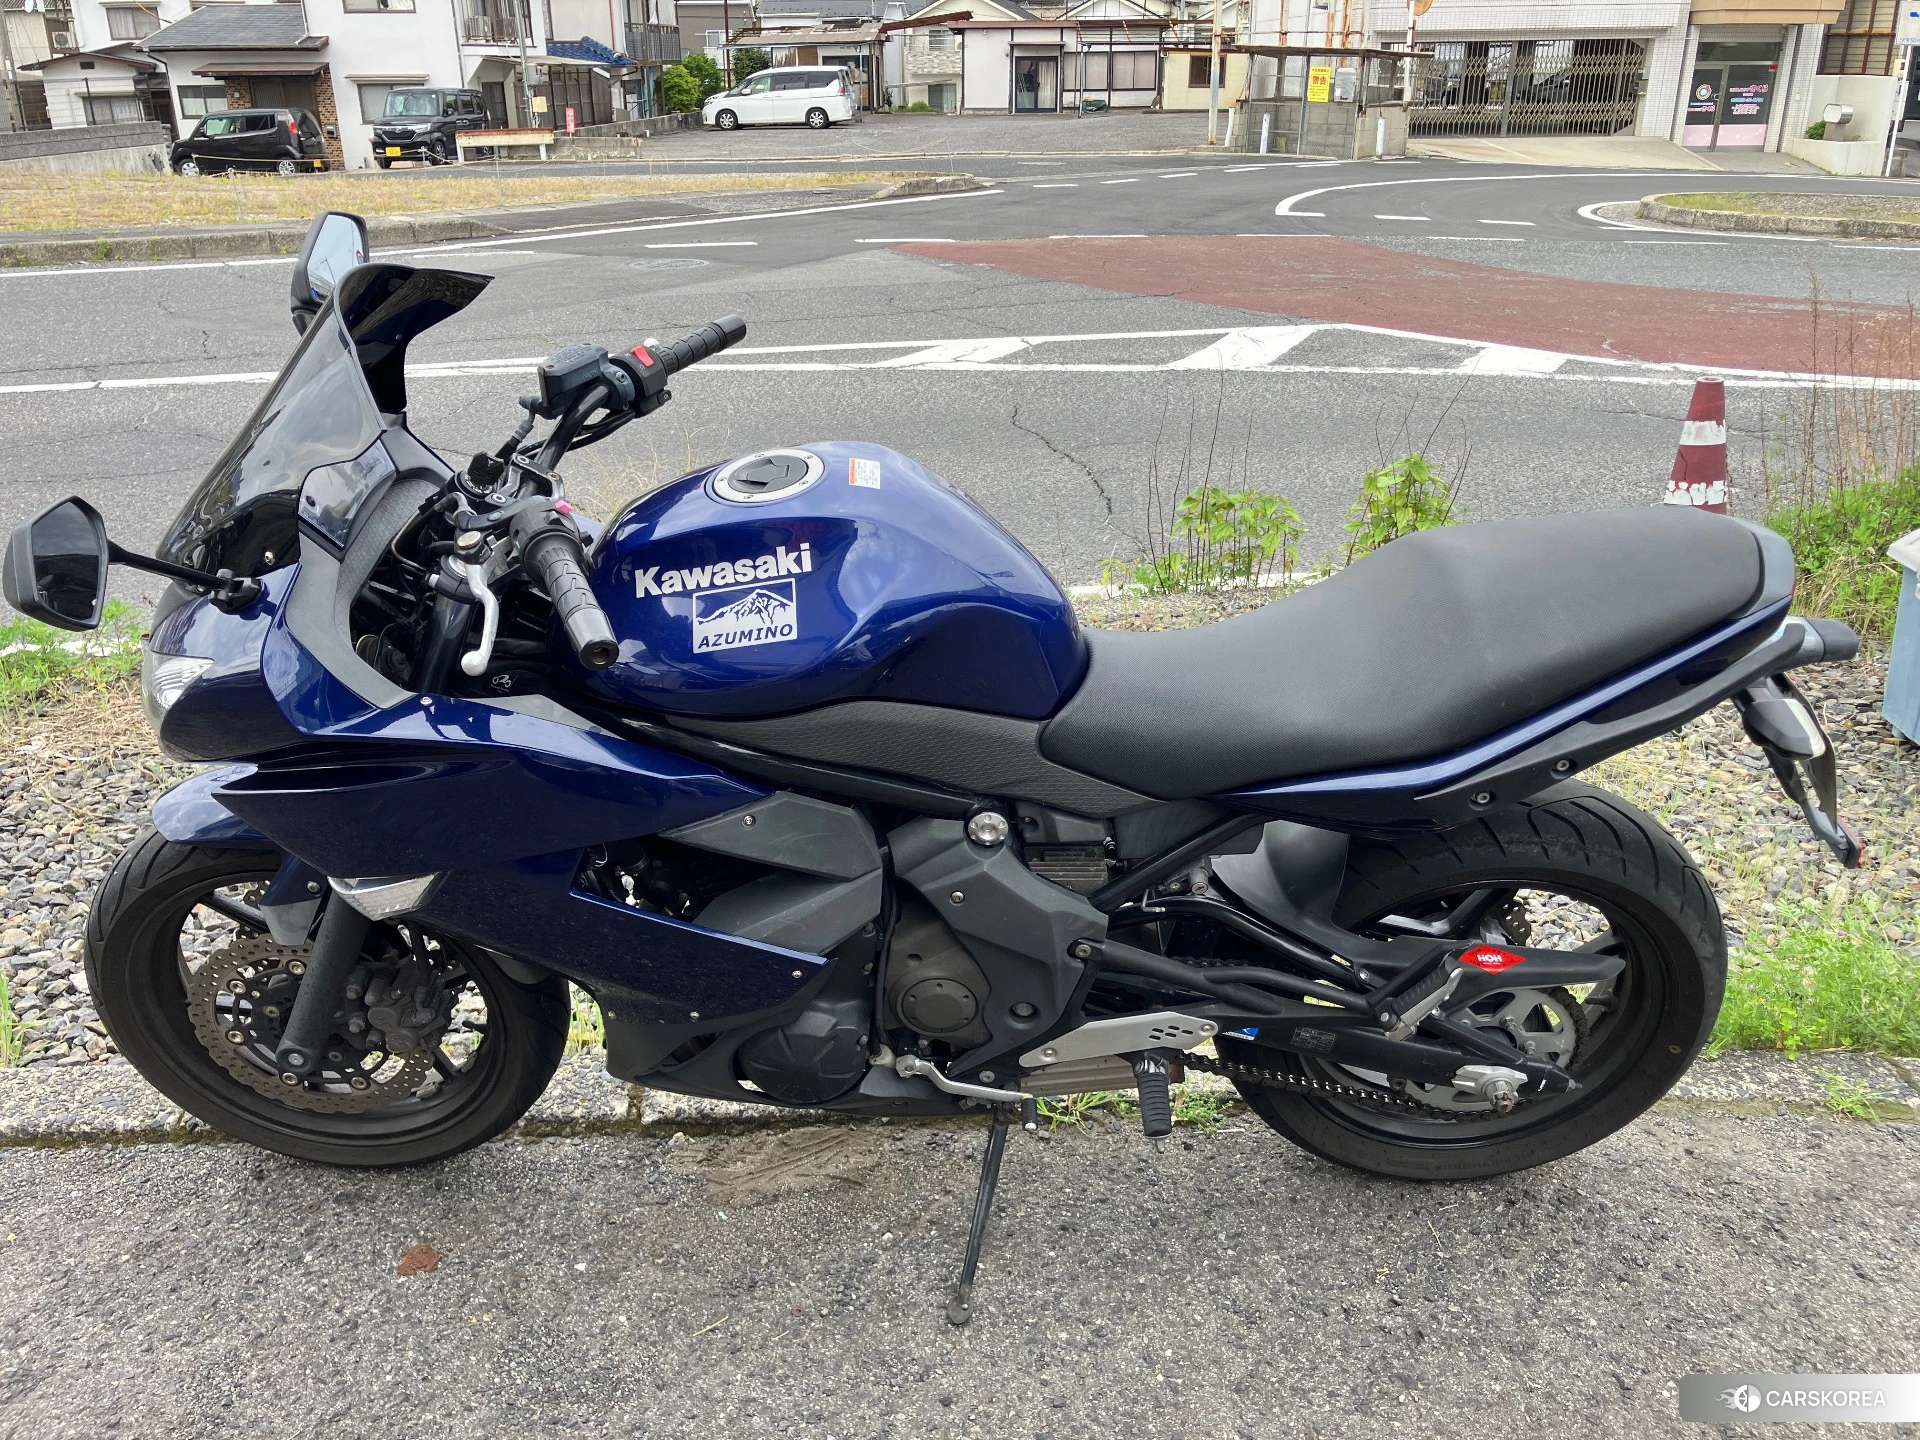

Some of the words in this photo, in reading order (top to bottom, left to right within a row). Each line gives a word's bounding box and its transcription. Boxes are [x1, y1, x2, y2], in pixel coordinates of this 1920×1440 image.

[1312, 76, 1327, 85] 警告
[634, 542, 812, 599] Kawasaki
[698, 623, 793, 650] AZUMINO
